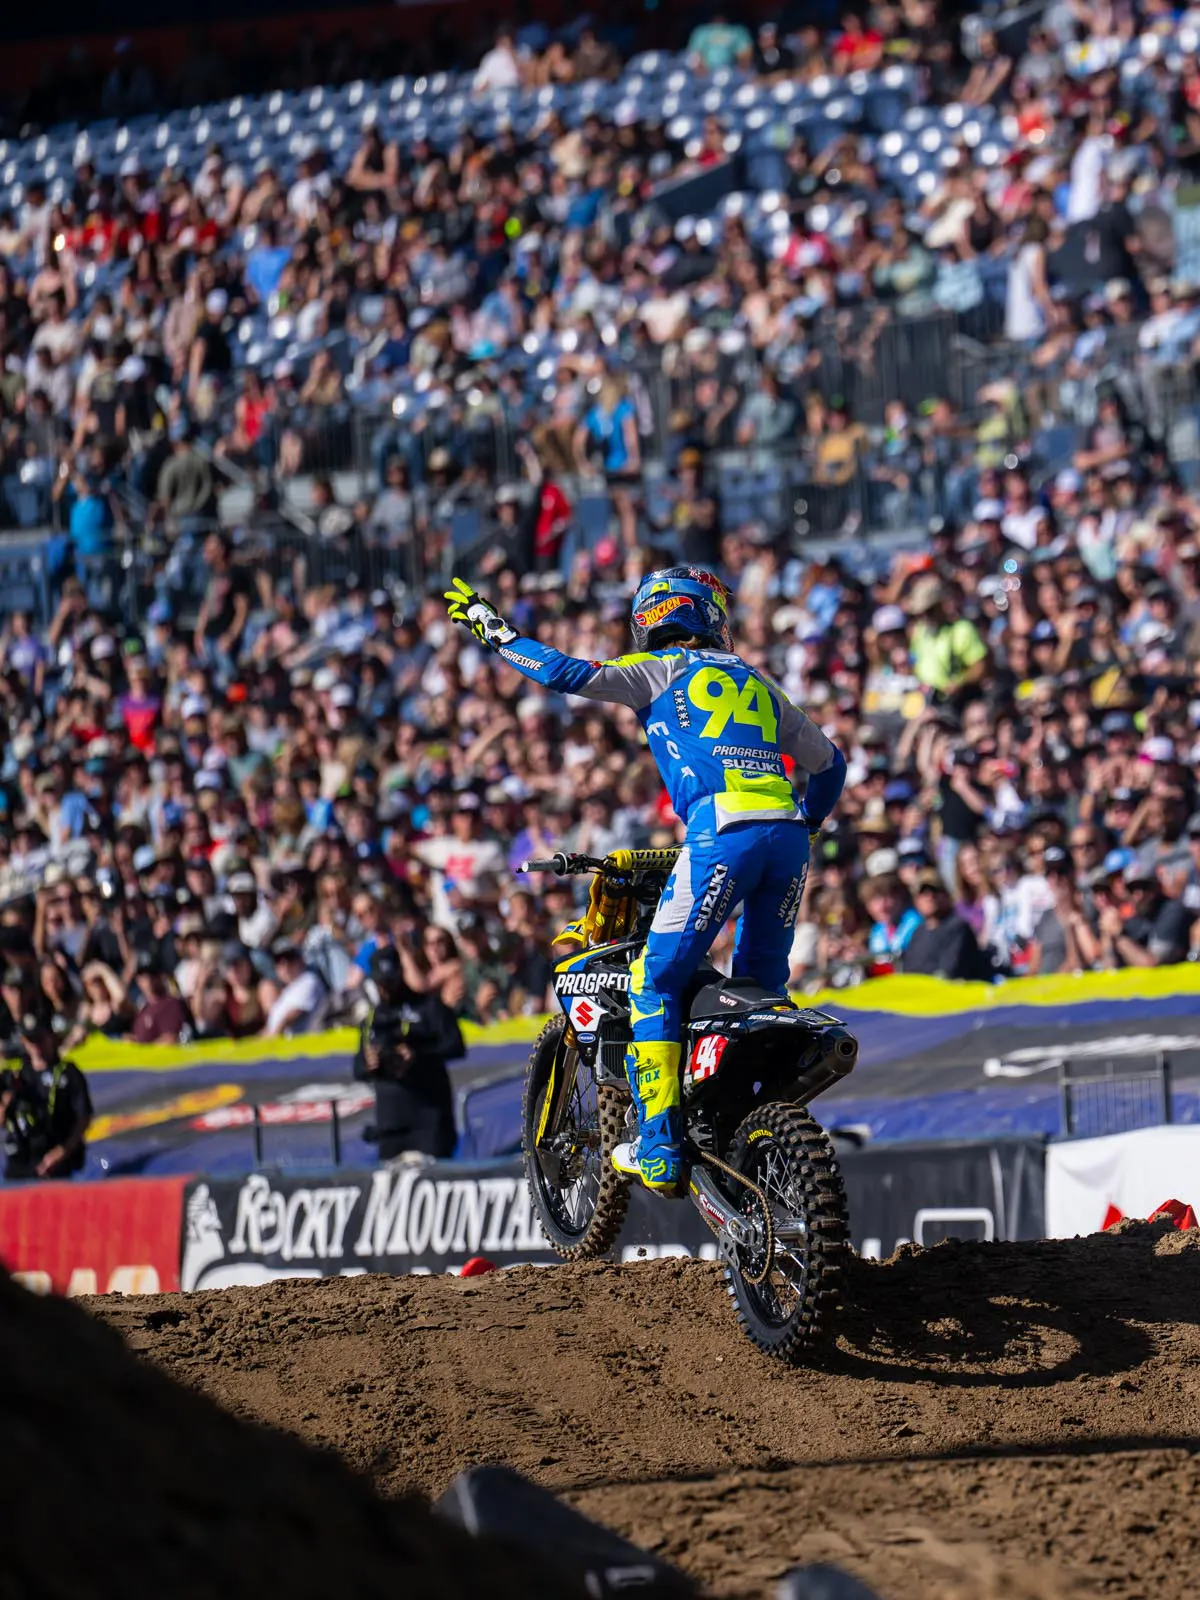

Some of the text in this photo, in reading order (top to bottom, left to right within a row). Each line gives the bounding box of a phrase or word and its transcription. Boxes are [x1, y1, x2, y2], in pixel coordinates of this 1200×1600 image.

[688, 666, 778, 744] 94
[712, 745, 782, 762] PROGRESSIVE
[721, 758, 781, 774] SUZUKI
[694, 863, 729, 932] SUZUKI
[714, 878, 736, 923] ECSTAR
[639, 1069, 660, 1086] FOX
[693, 1035, 719, 1080] 94
[748, 1128, 774, 1143] DUNLOP
[229, 1169, 566, 1261] ROCKY MOUNTA
